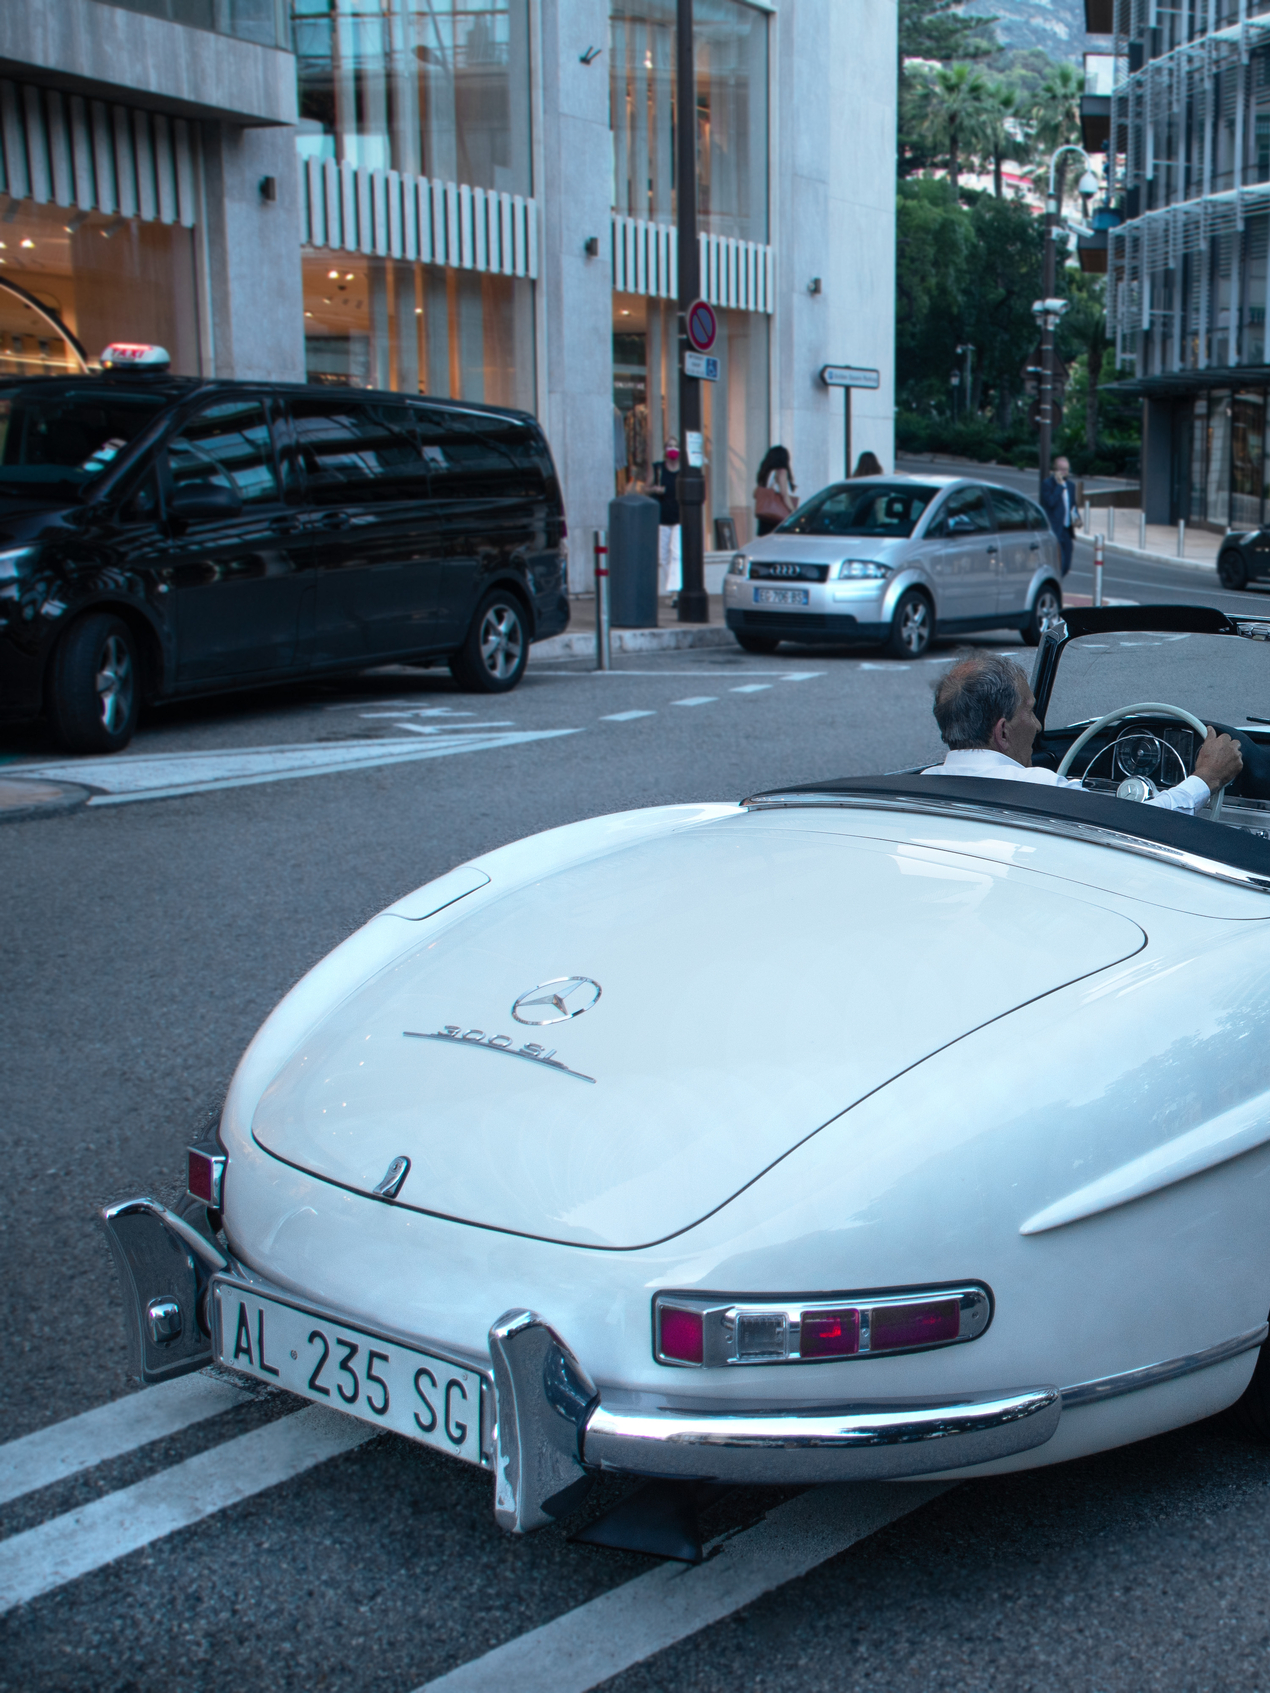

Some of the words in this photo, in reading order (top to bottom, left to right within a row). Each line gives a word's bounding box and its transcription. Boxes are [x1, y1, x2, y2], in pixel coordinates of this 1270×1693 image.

[111, 347, 146, 358] TAXI
[436, 1025, 513, 1049] 300
[519, 1042, 569, 1070] SL
[233, 1301, 281, 1377] AL
[307, 1329, 391, 1416] 235
[413, 1366, 468, 1445] SG
